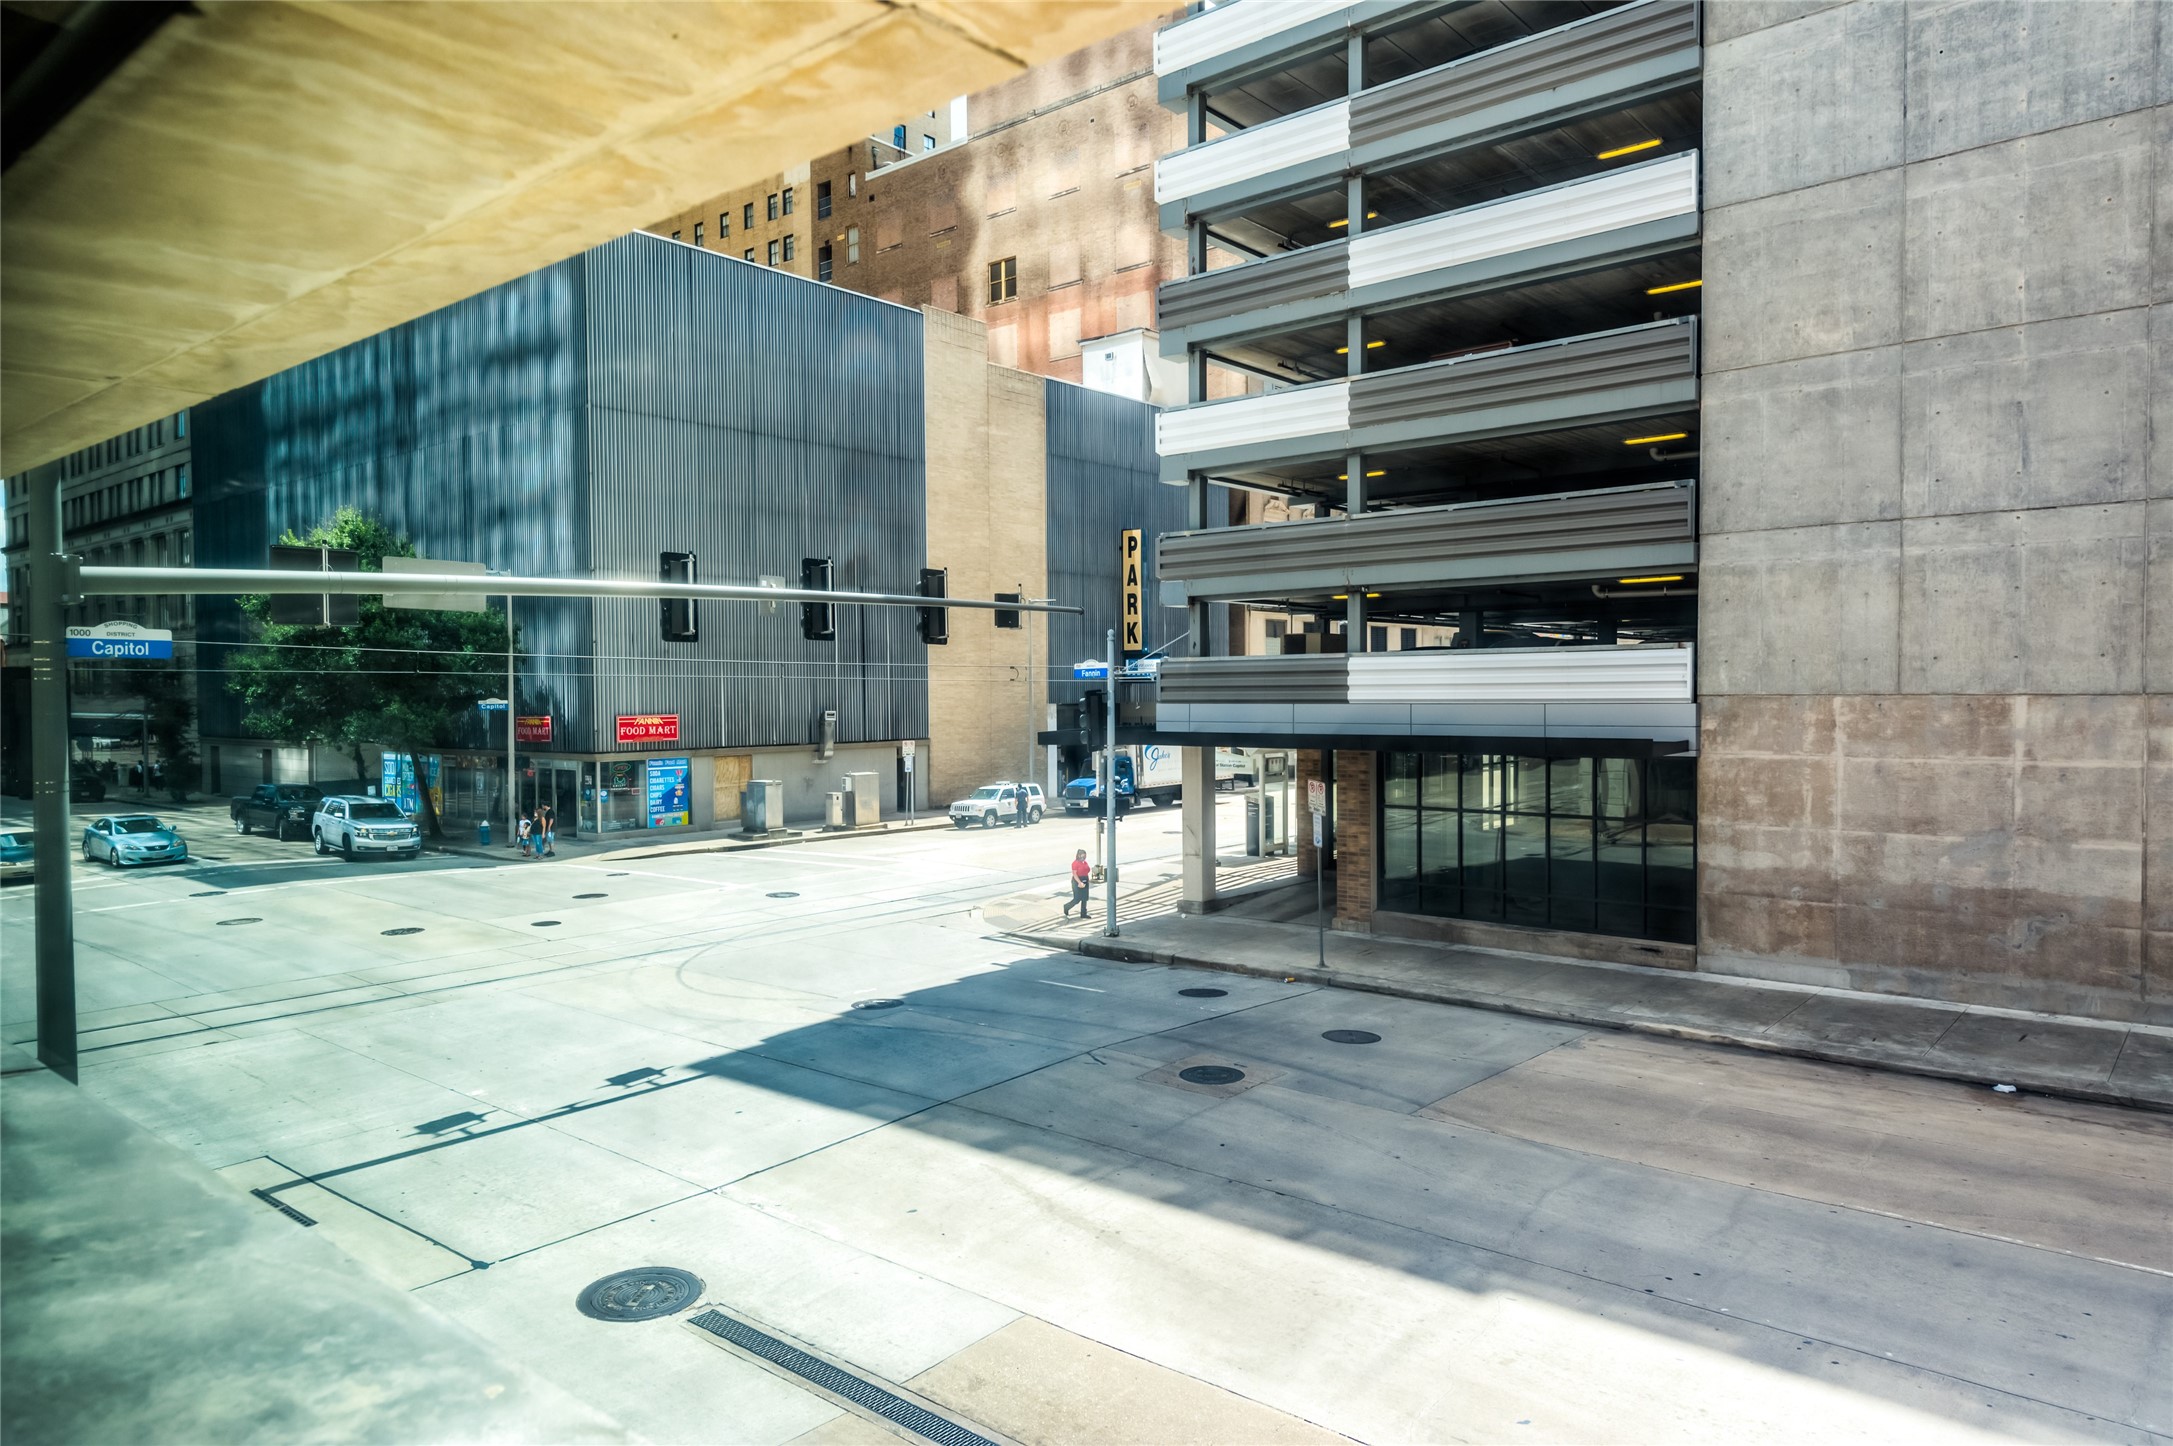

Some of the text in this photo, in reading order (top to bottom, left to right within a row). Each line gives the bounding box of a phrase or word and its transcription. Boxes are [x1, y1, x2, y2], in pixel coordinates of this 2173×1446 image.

[1127, 536, 1138, 644] PARK
[104, 621, 138, 629] SHOPPING
[92, 641, 149, 657] Capitol
[1081, 669, 1101, 677] Fannin
[634, 717, 664, 725] FANNIN
[518, 727, 549, 735] FOOD MART
[620, 726, 676, 735] FOOD MART
